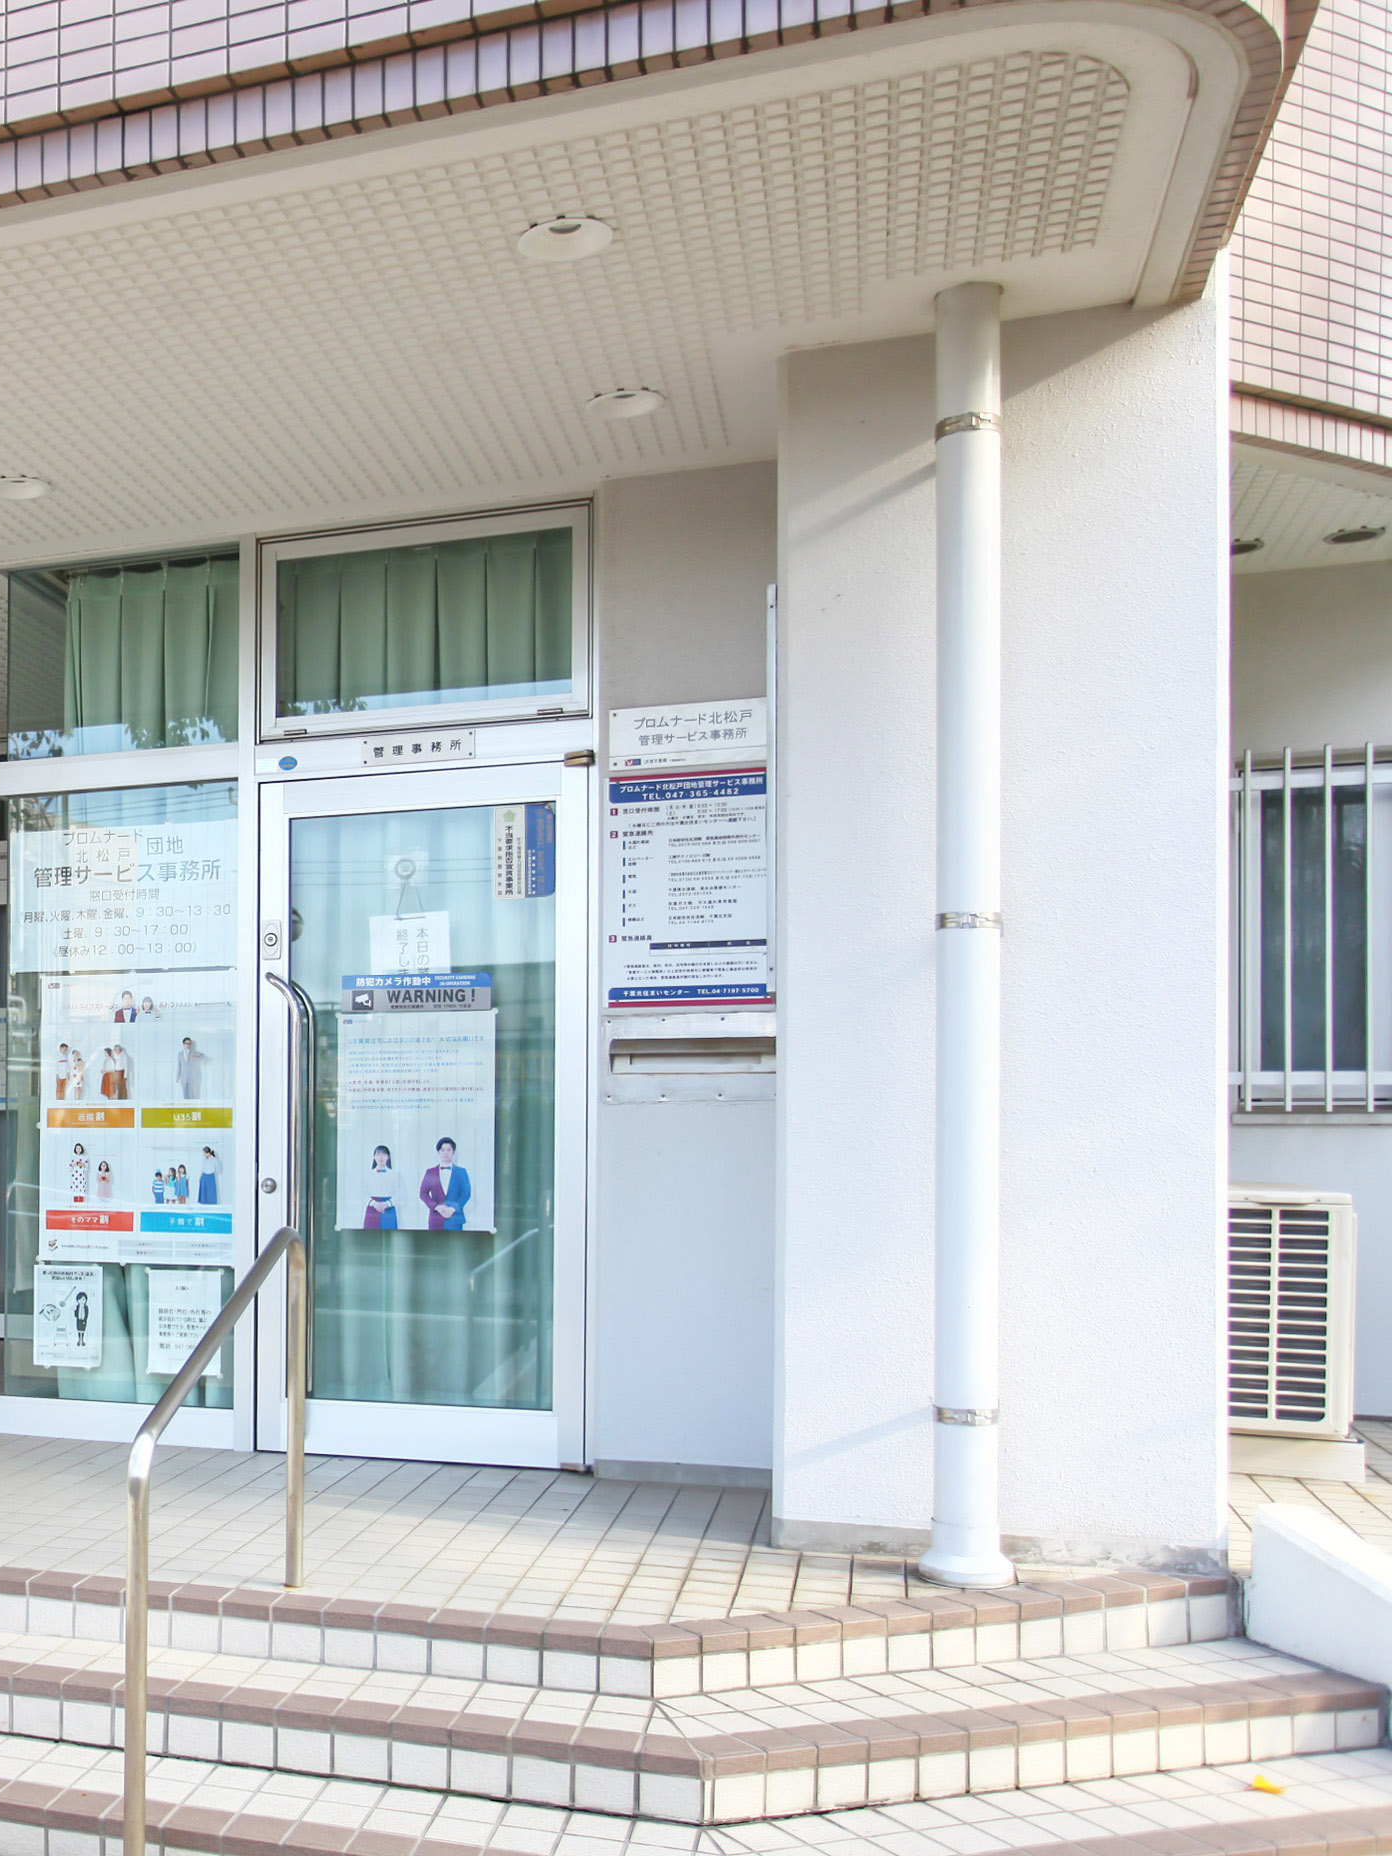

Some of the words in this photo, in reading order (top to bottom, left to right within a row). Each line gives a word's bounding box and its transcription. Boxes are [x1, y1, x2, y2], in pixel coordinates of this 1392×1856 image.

[633, 709, 753, 731] プロムナード北松戸
[638, 727, 748, 747] 管理サービス事務所
[372, 738, 462, 759] 管理事務所
[63, 826, 144, 847] プロムナード
[146, 836, 185, 856] 団地
[75, 846, 132, 865] 北松戸
[32, 857, 223, 889] 管理サービス事務所
[89, 887, 161, 903] 窓口受付時間
[355, 976, 432, 988] 防犯カメラ作動中
[70, 1214, 110, 1225] そのママ割
